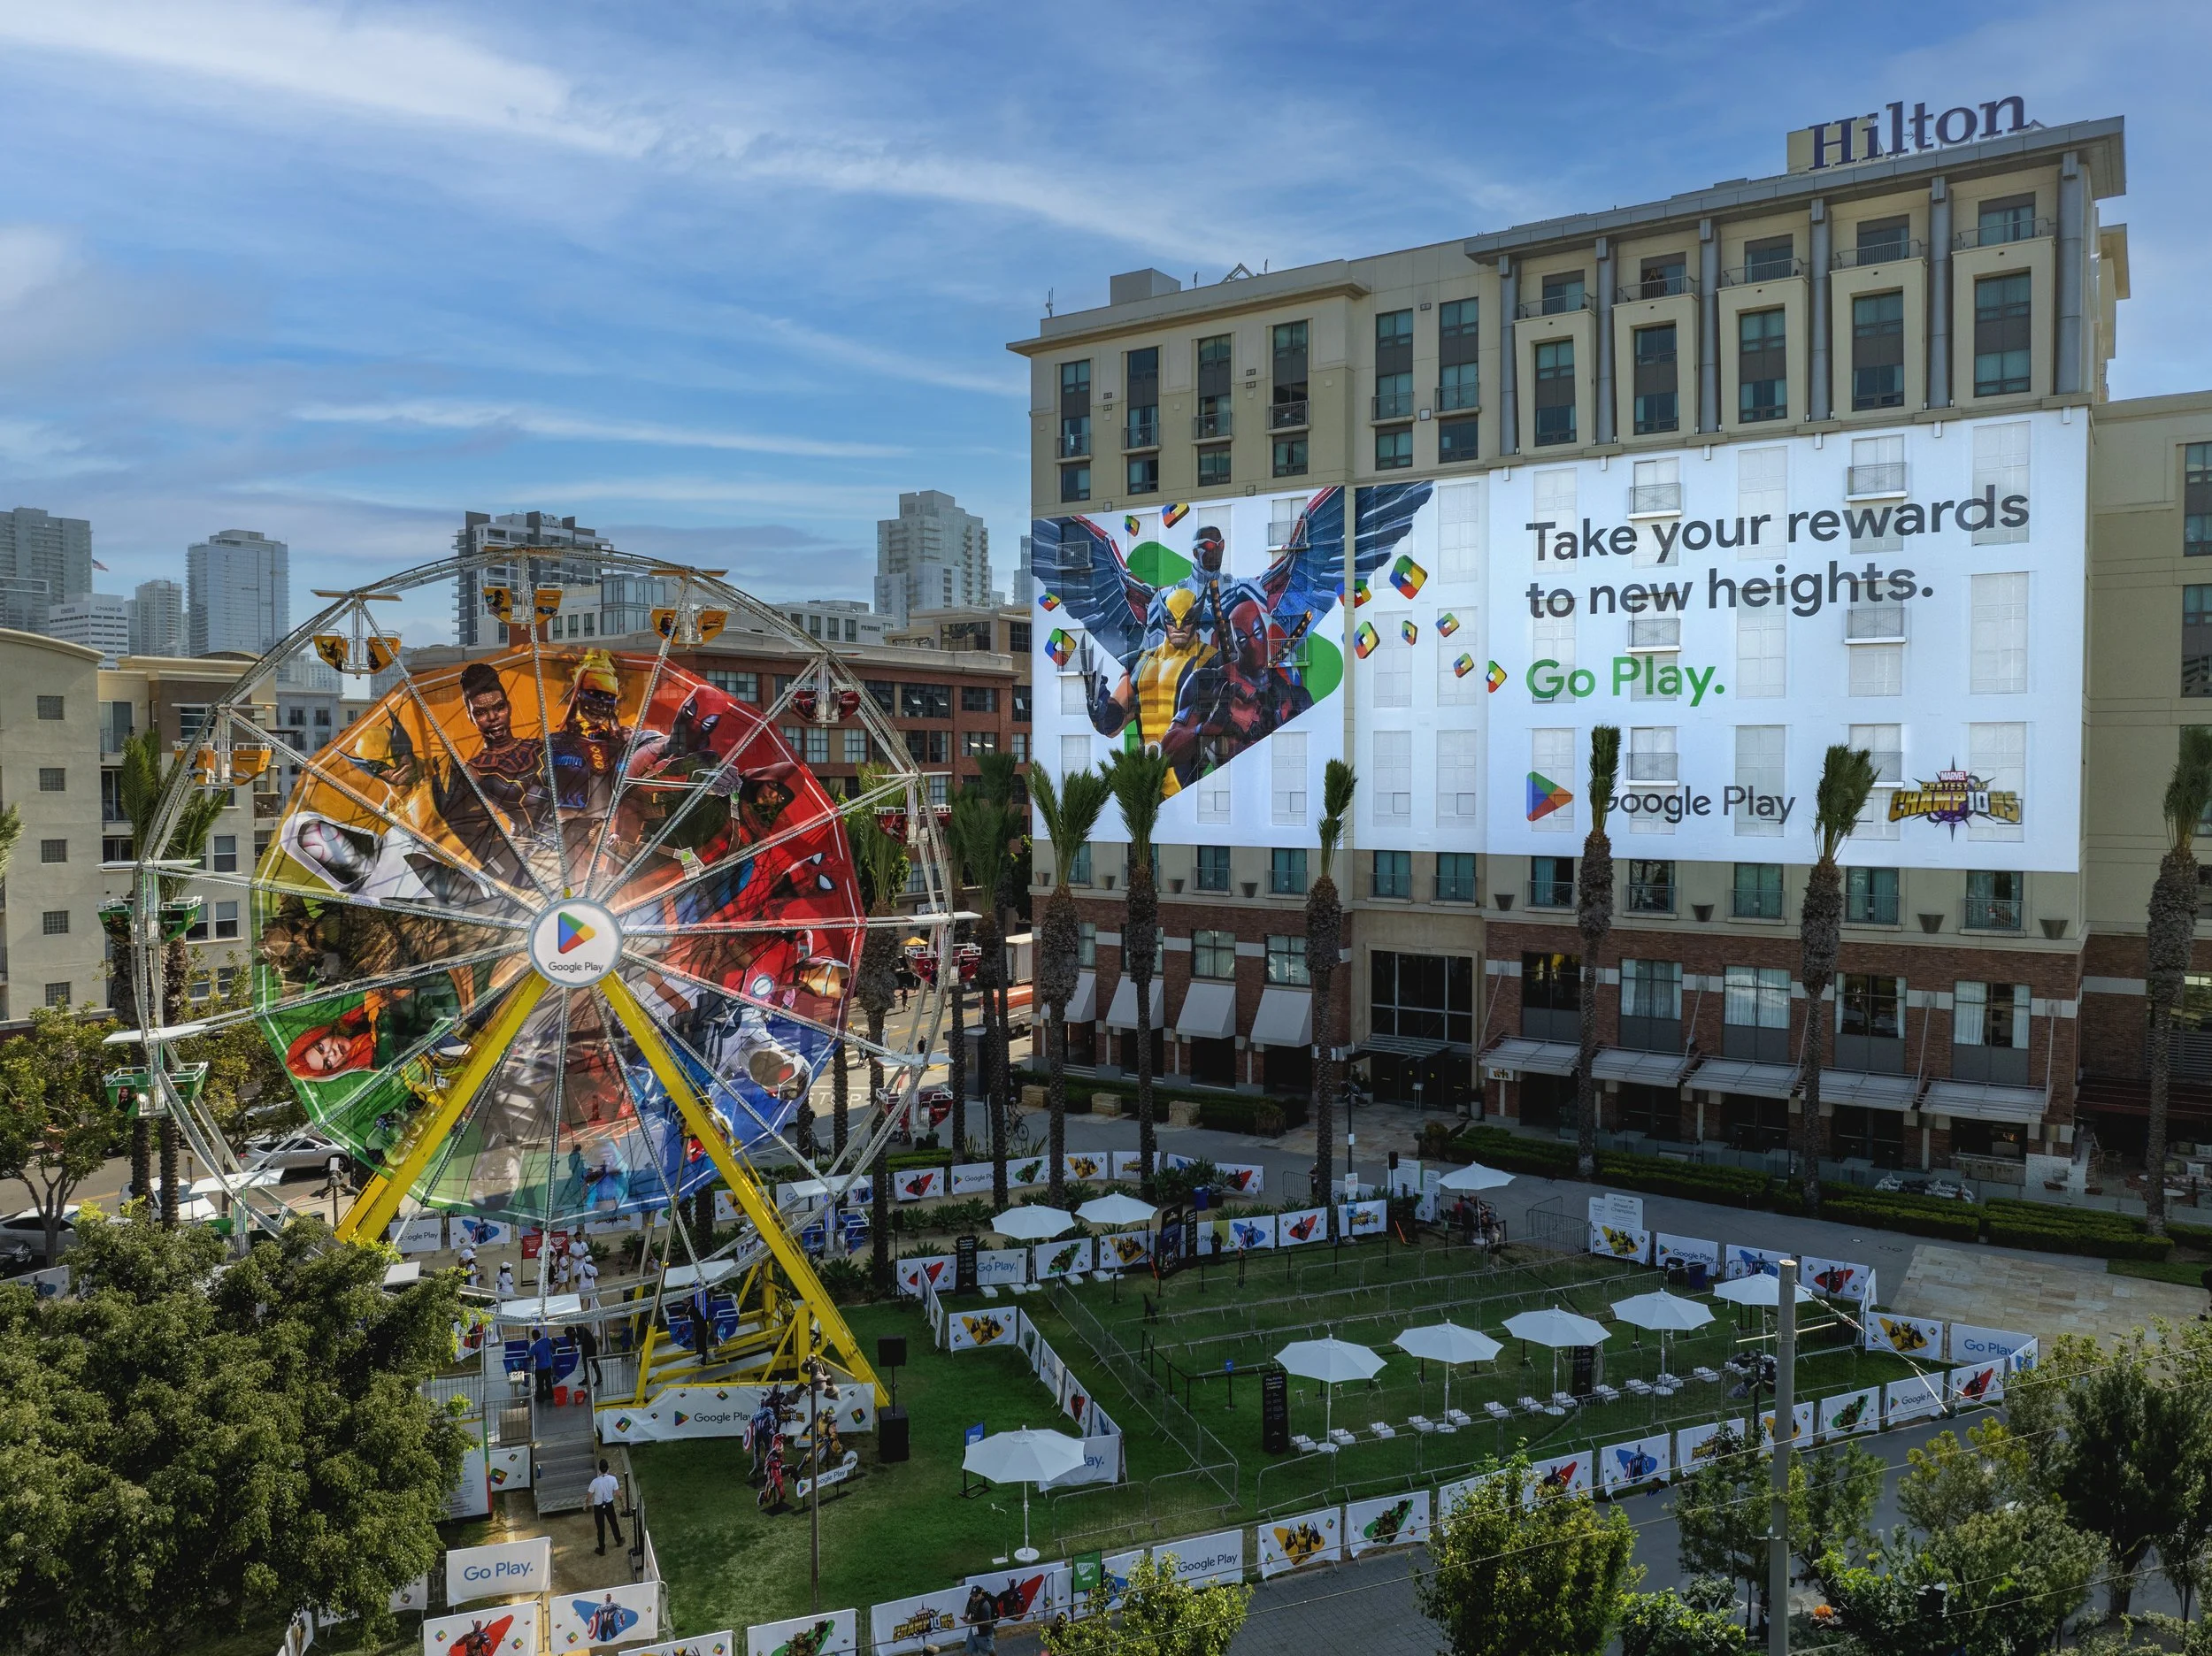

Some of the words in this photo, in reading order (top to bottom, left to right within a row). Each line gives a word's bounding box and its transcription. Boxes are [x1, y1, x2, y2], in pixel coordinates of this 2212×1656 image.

[1809, 96, 2032, 171] Hilton
[1525, 516, 1638, 562] Take
[1651, 514, 1770, 564] your
[1788, 484, 2030, 543] rewards
[1525, 582, 1575, 618] to
[1591, 581, 1693, 615] new
[1709, 560, 1933, 617] heights.
[1525, 658, 1595, 699] Go
[1612, 656, 1725, 707] Play.
[1940, 771, 1966, 781] MARVEL
[1922, 782, 1969, 791] CONTEST
[1975, 782, 1988, 791] OF
[1724, 785, 1796, 824] Play
[549, 962, 582, 973] Google
[584, 962, 603, 972] Play
[809, 1092, 862, 1107] STP
[965, 1174, 985, 1183] Google
[1673, 1248, 1698, 1260] Google
[1700, 1253, 1715, 1262] Play
[977, 1261, 992, 1272] Go
[995, 1261, 1017, 1272] Play.
[1964, 1338, 1985, 1352] Go
[1902, 1393, 1926, 1406] Google
[695, 1412, 731, 1423] Google
[1083, 1454, 1105, 1468] lay.
[817, 1475, 833, 1486] oogle
[833, 1468, 846, 1481] Play
[1178, 1556, 1215, 1573] Google
[1217, 1552, 1239, 1565] Play
[464, 1566, 491, 1581] Go
[495, 1561, 534, 1577] Play.
